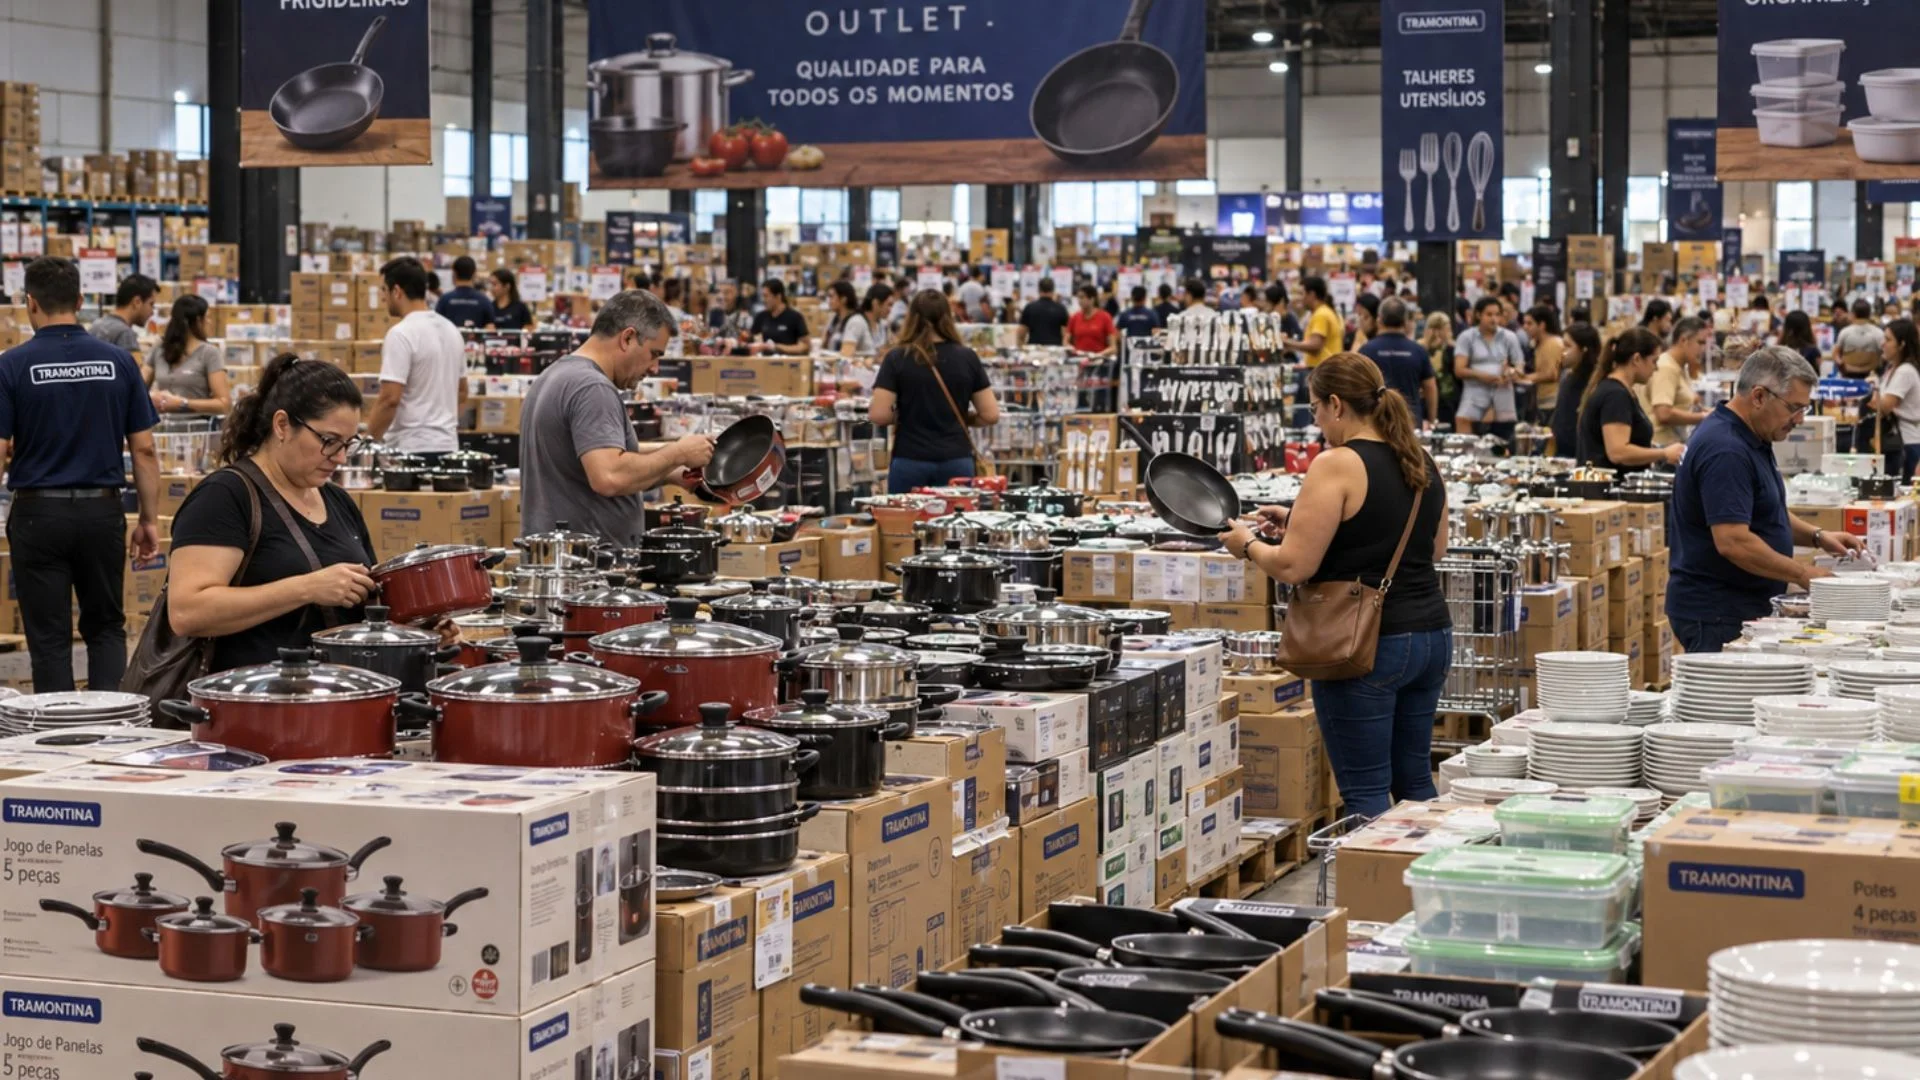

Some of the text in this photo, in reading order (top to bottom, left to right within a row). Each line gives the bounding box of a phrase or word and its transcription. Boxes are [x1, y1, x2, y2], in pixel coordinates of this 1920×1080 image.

[805, 5, 967, 36] OUTLET
[1405, 15, 1478, 29] TRAMONTINA
[796, 56, 987, 80] QUALIDADE PARA
[1402, 68, 1475, 85] TALHERES
[767, 82, 1015, 107] TODOS OS MOMENTOS
[1400, 87, 1486, 108] UTENSÍLIOS
[37, 364, 112, 380] TRAMONTINA
[9, 804, 94, 822] TRAMONTINA
[3, 837, 104, 858] Jogo de Panelas
[3, 858, 61, 888] 5 peças
[1678, 869, 1795, 892] TRAMONTINA
[1853, 880, 1897, 899] Potes
[793, 887, 833, 916] RAMONTIN
[1853, 903, 1918, 925] 4 peças
[9, 998, 95, 1018] TRAMONTINA
[1582, 993, 1677, 1014] TRAMONTINA
[3, 1032, 104, 1056] Jogo de Panelas
[3, 1053, 14, 1076] 5
